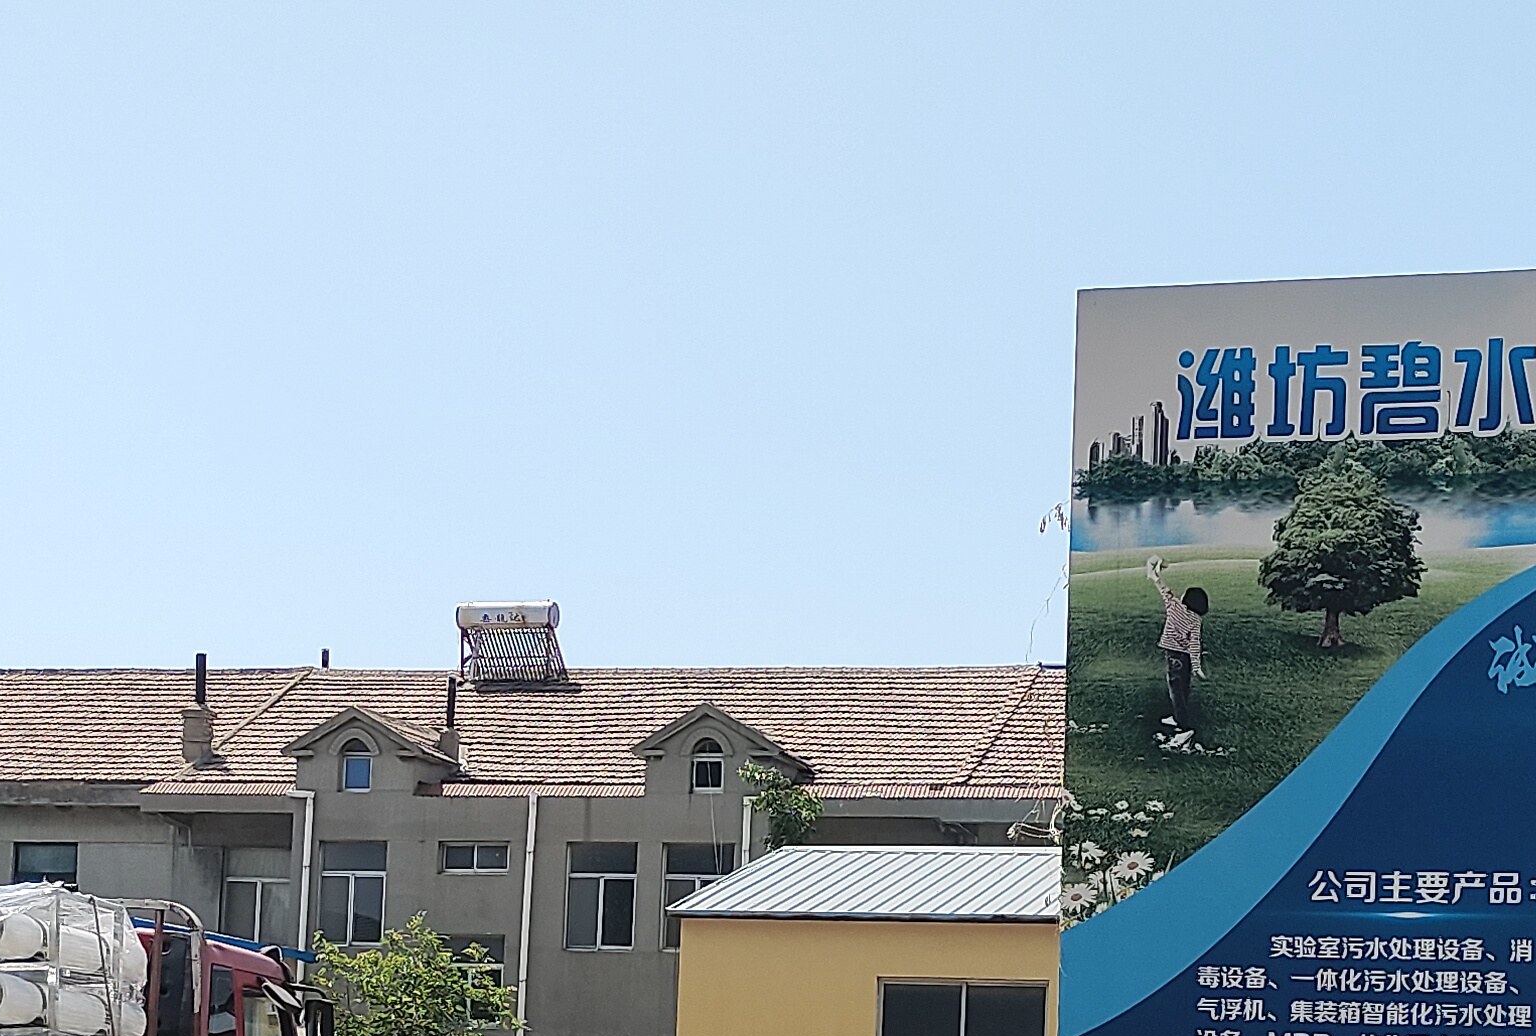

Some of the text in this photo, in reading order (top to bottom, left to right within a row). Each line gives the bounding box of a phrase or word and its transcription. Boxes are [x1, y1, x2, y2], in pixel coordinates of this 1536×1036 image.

[1269, 934, 1533, 963] 实验室污水处理设备、消
[1196, 965, 1521, 996] 毒设备、一体化污水处理设备、
[1196, 997, 1532, 1028] 气浮机、集装箱智能化污水处理
